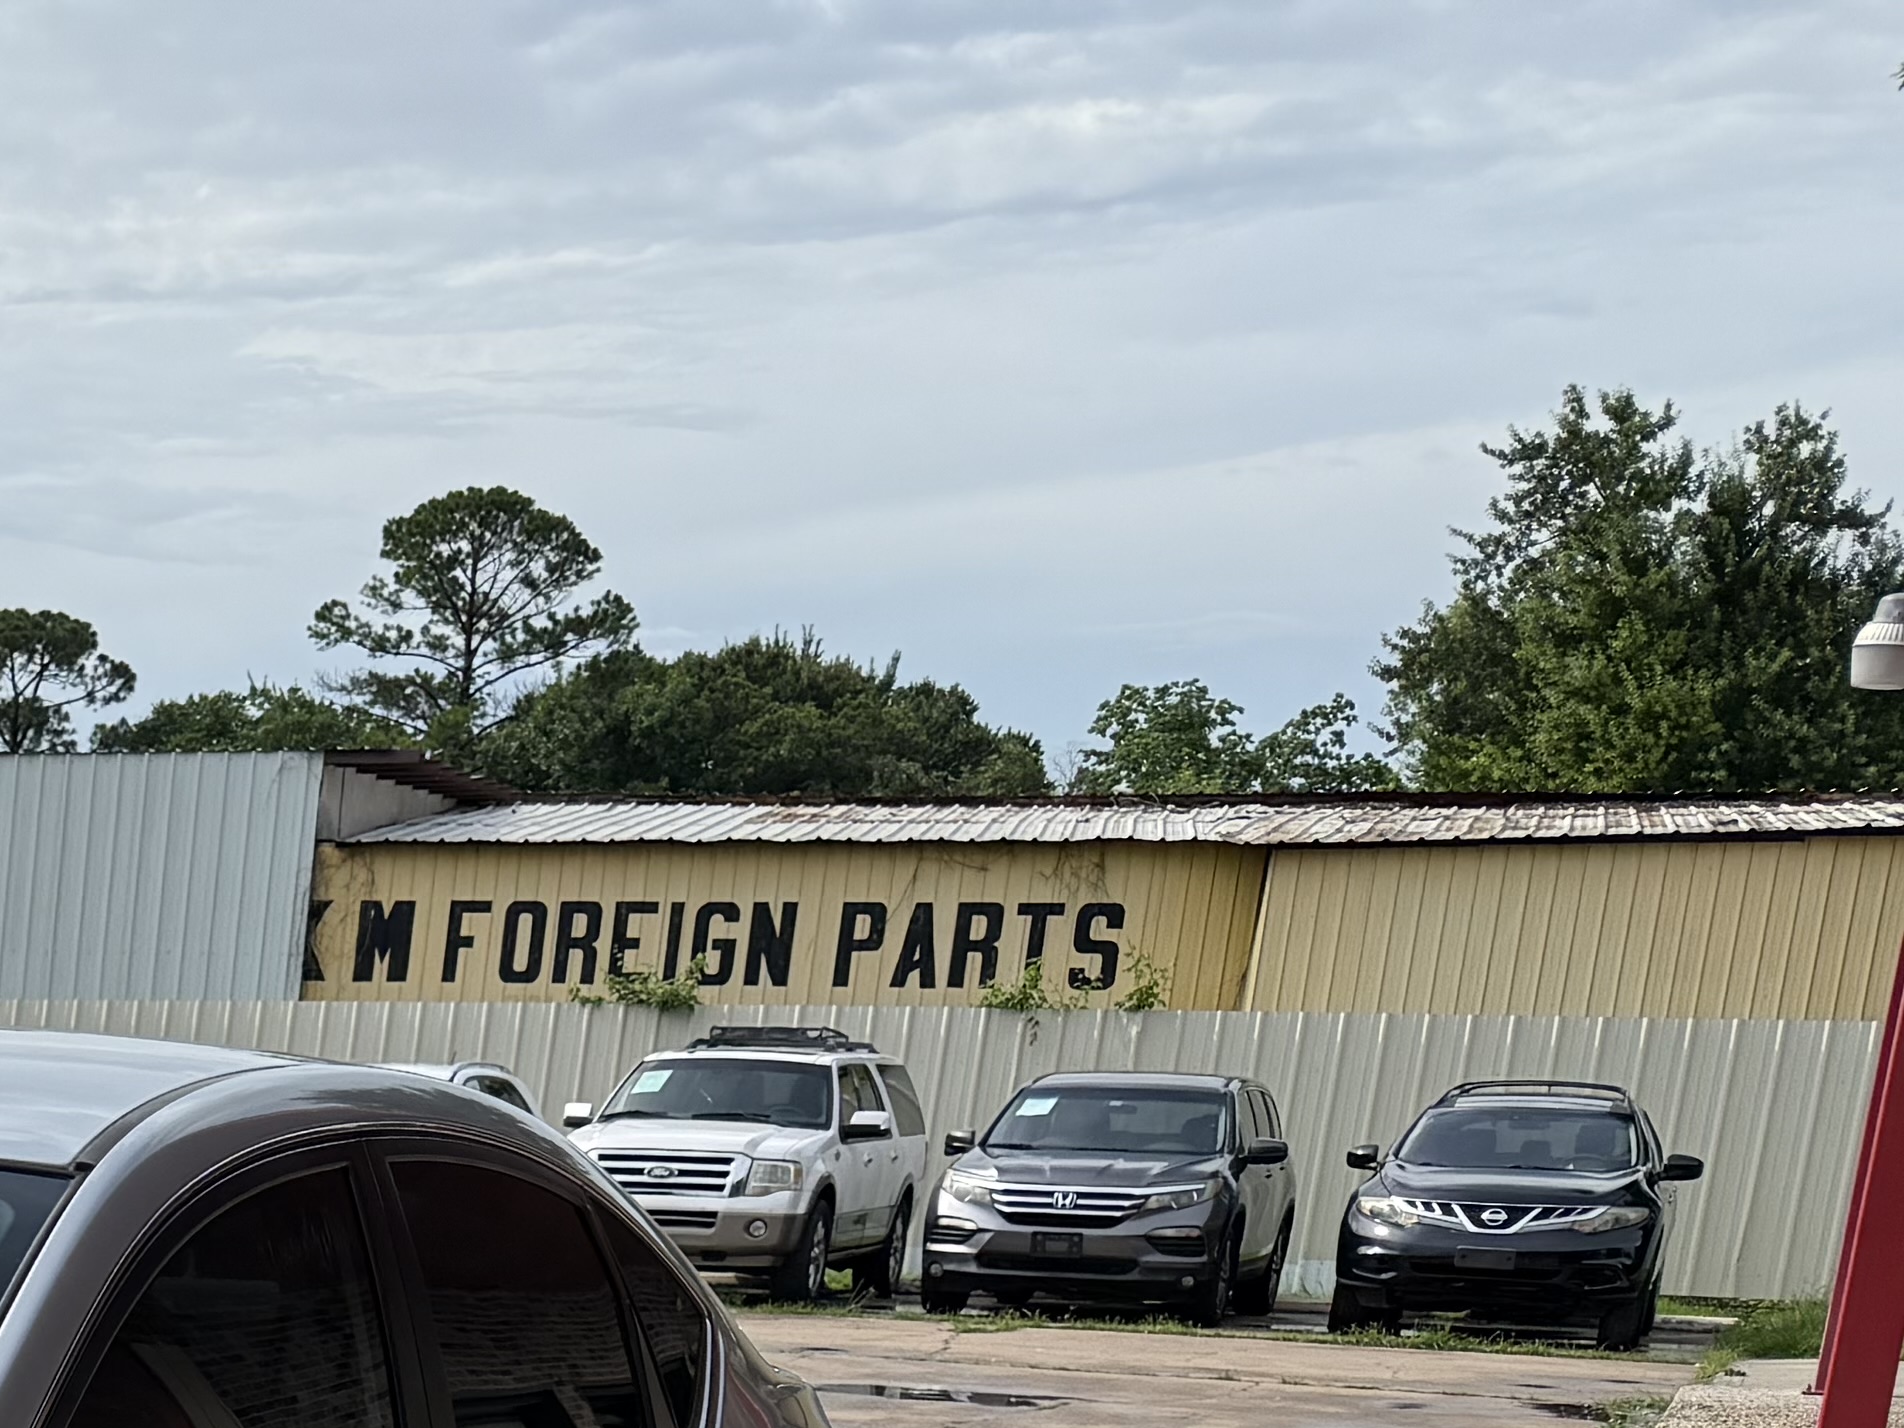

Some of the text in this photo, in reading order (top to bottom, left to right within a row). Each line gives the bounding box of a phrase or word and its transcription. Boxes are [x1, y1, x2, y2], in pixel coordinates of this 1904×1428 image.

[352, 899, 417, 982] M
[441, 900, 799, 987] FOREIGN
[831, 901, 1126, 991] PARTS
